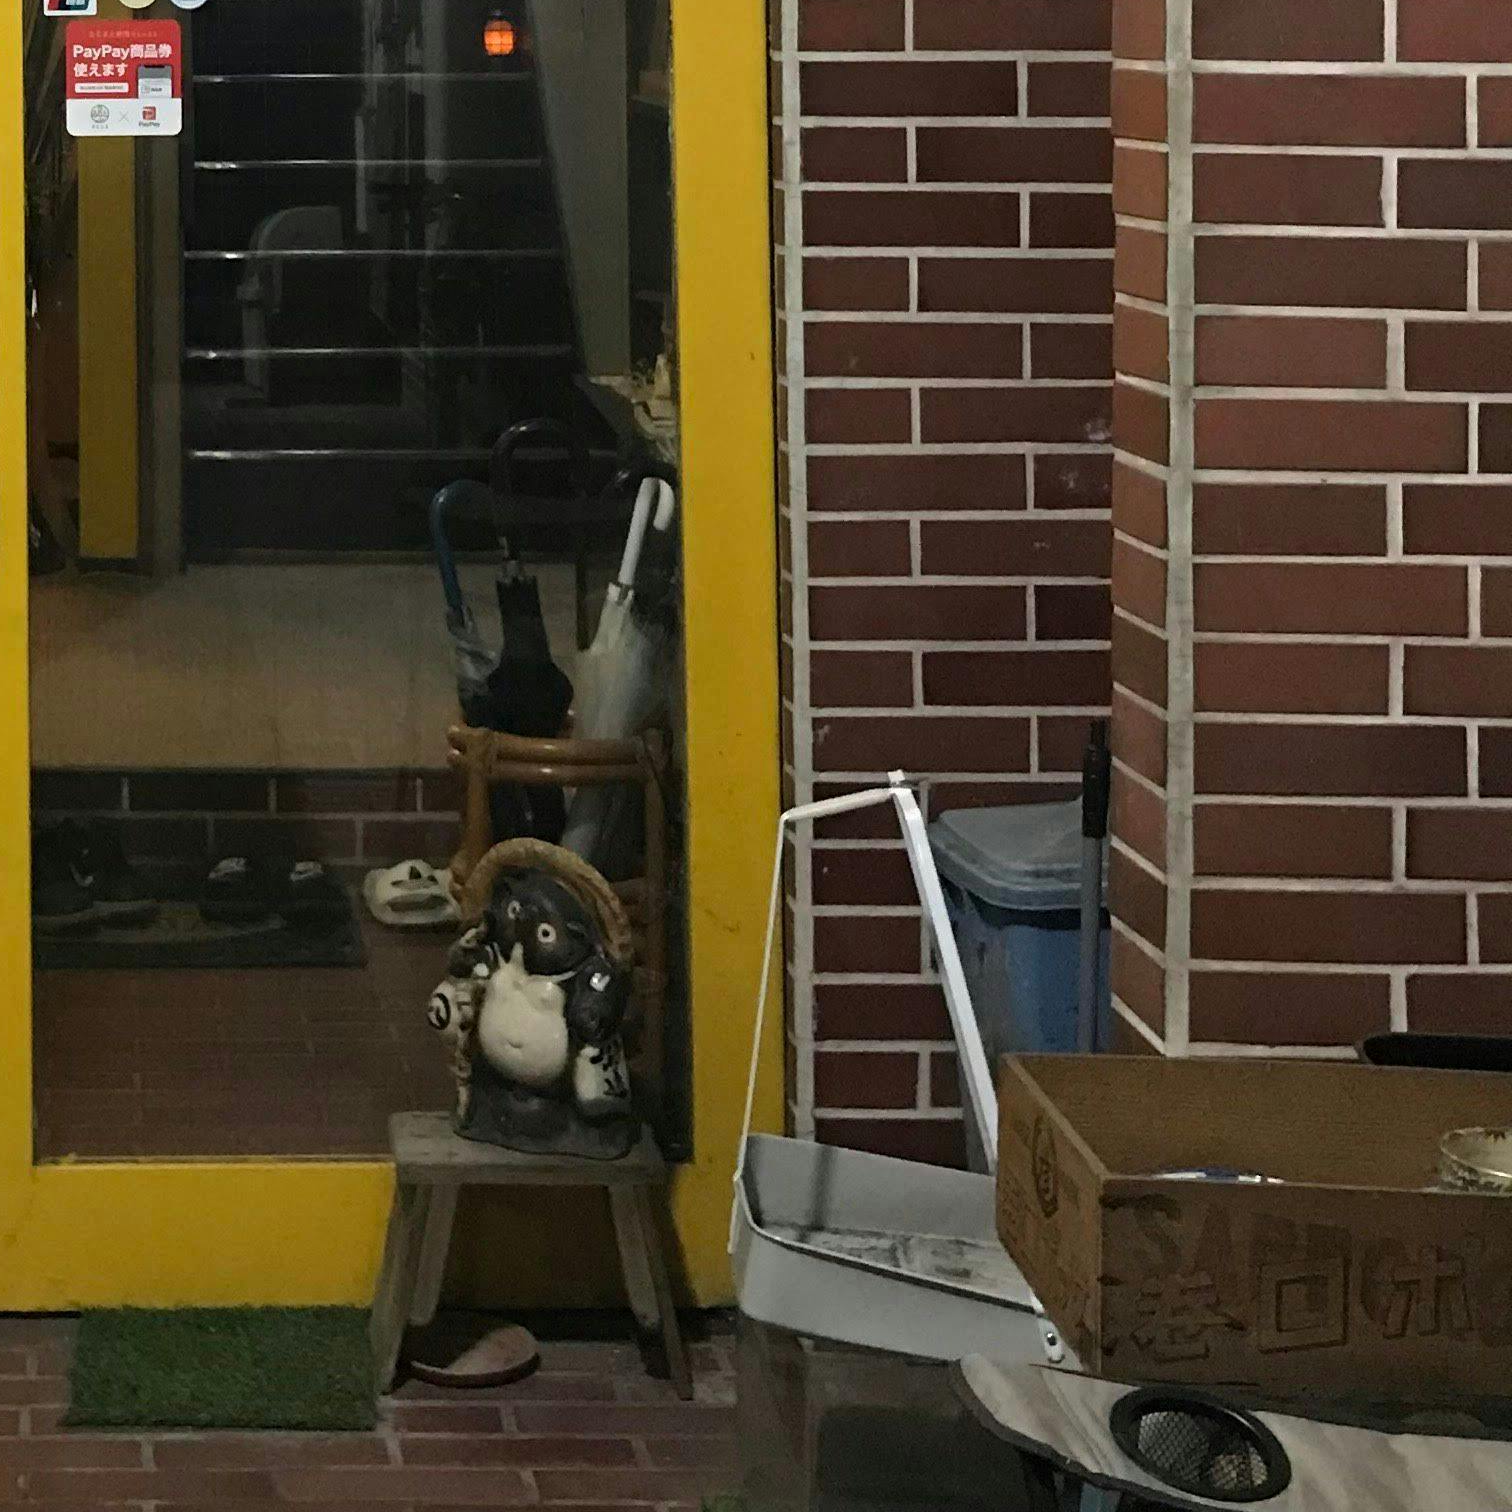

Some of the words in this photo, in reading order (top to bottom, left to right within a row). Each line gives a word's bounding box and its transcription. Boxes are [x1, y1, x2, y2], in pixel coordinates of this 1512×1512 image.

[73, 44, 172, 60] PayPay商品券
[74, 62, 128, 77] 使えます
